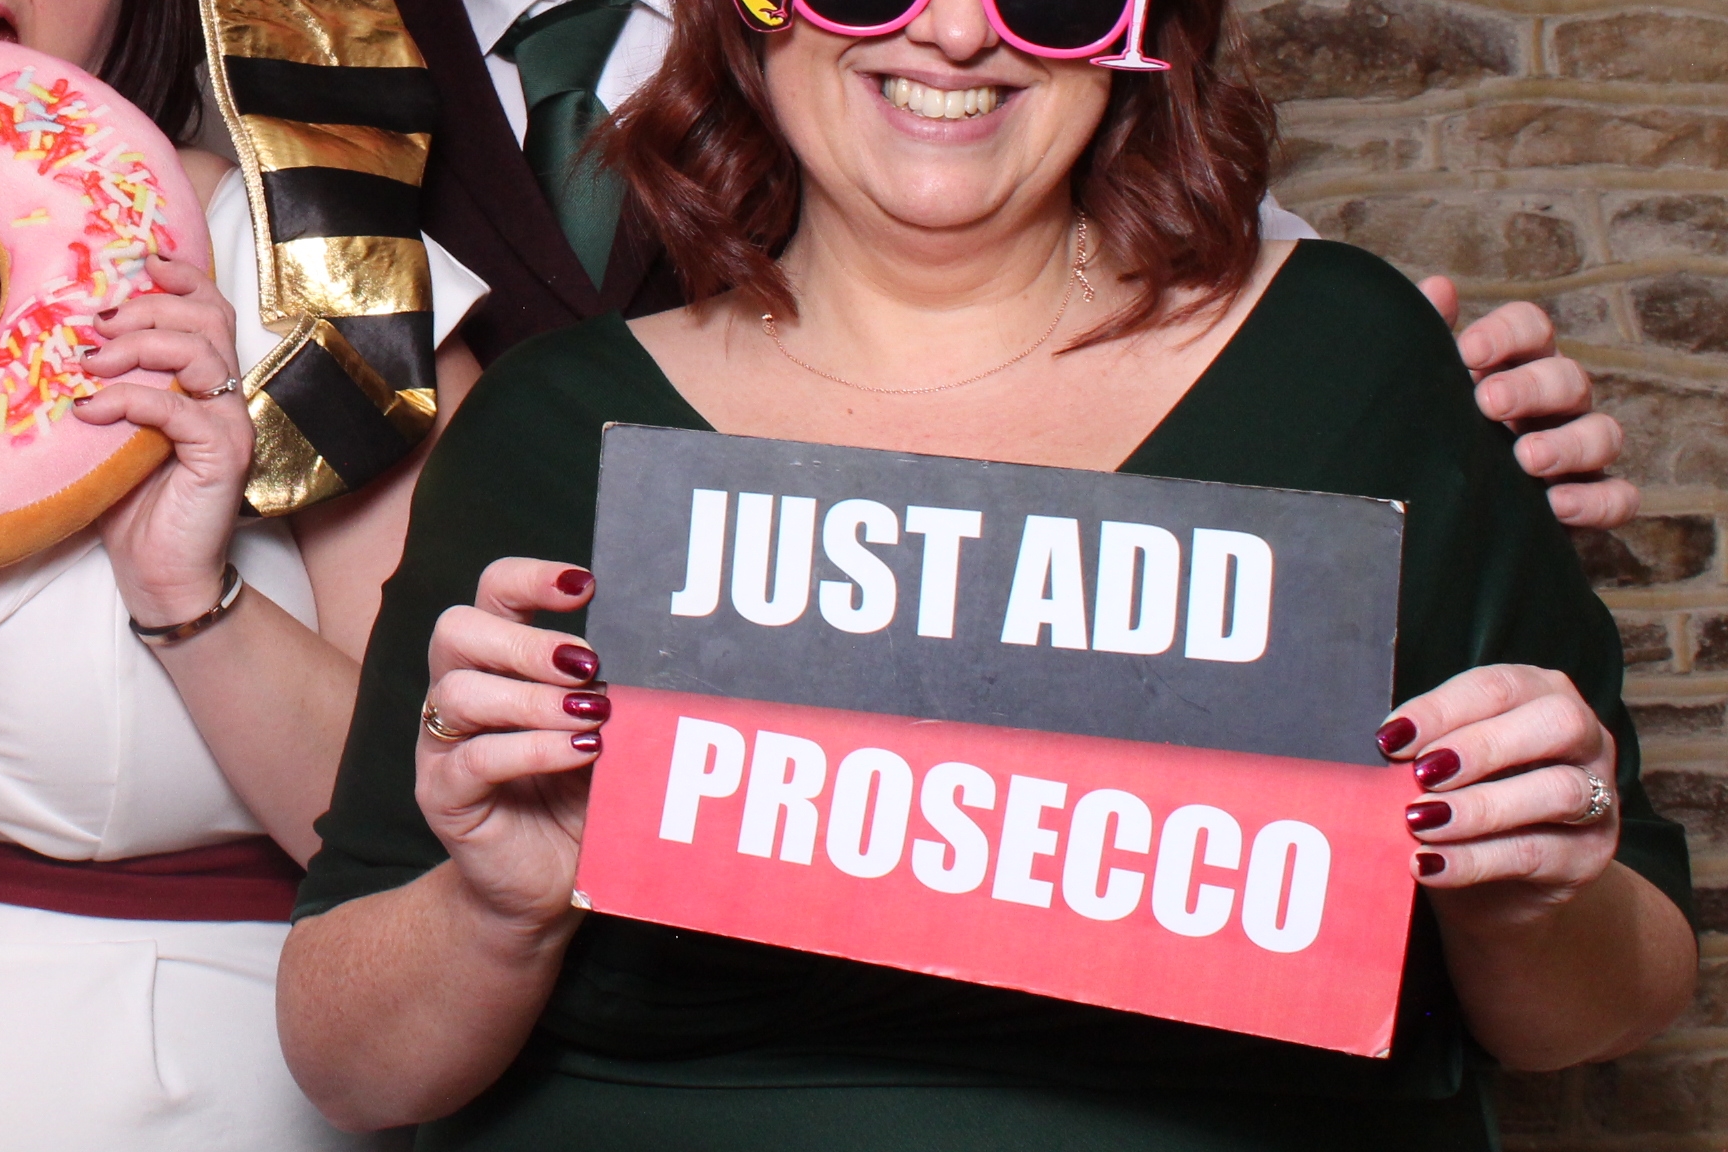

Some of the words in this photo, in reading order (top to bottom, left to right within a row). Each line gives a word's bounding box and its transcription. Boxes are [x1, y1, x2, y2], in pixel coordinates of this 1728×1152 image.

[670, 488, 983, 639] JUST
[1000, 514, 1274, 663] ADD
[658, 715, 1333, 954] PROSECCO
